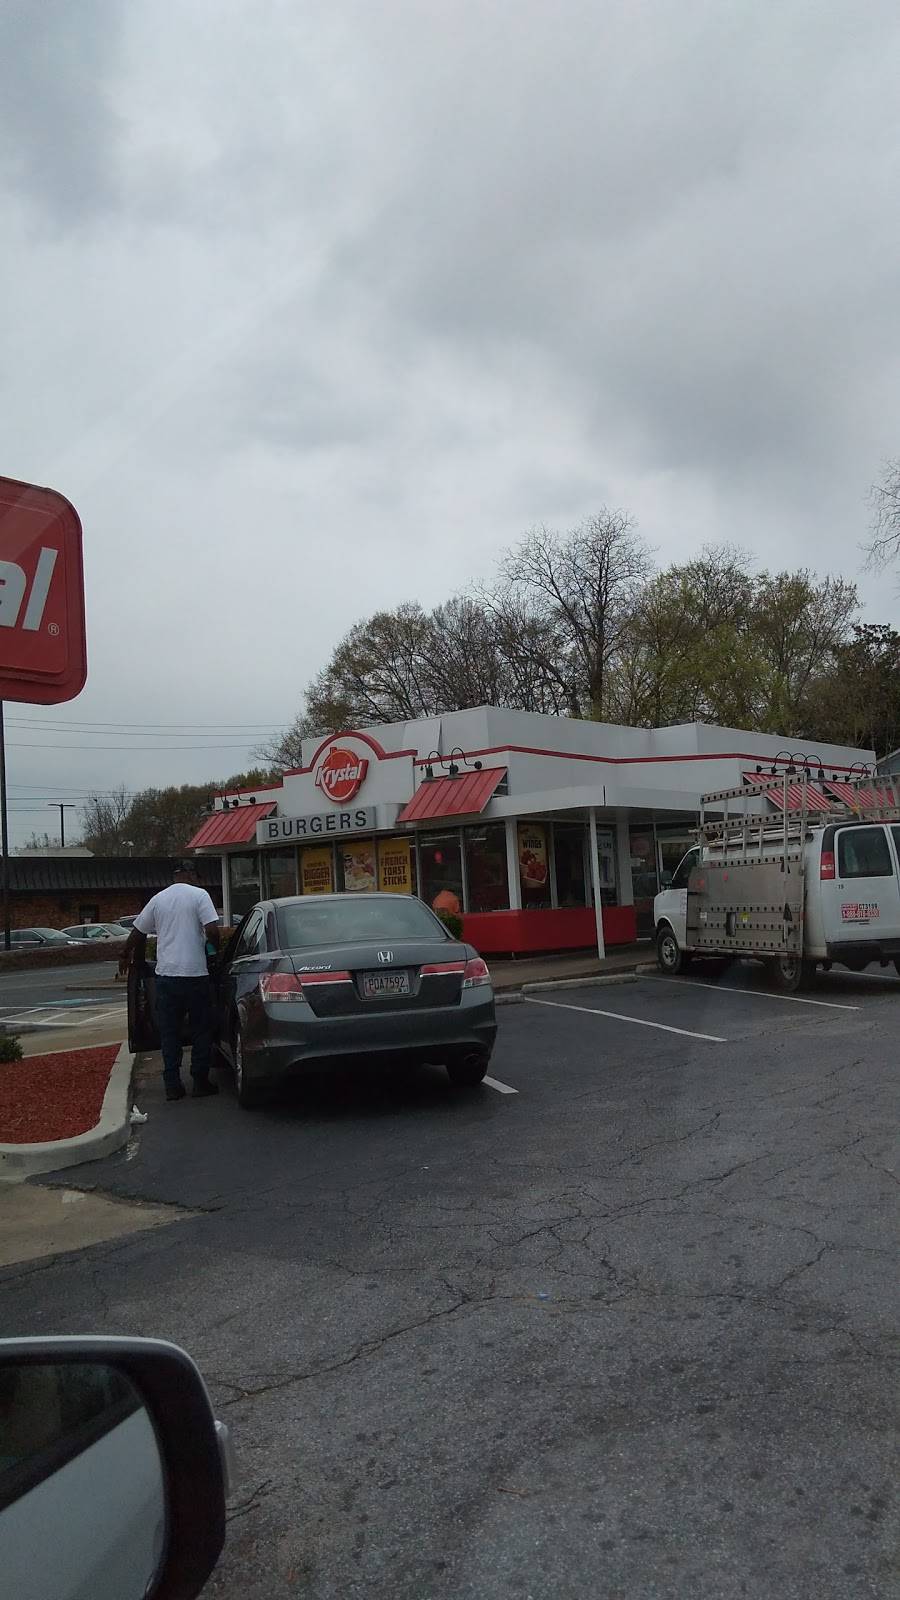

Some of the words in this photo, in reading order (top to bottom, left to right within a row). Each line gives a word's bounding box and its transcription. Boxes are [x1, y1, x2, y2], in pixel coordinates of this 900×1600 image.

[315, 761, 363, 789] Krystal
[268, 809, 367, 838] BURGERS
[522, 840, 542, 849] WINGS
[383, 866, 406, 876] TOAST
[383, 875, 407, 886] STICKS
[297, 964, 332, 972] Accord
